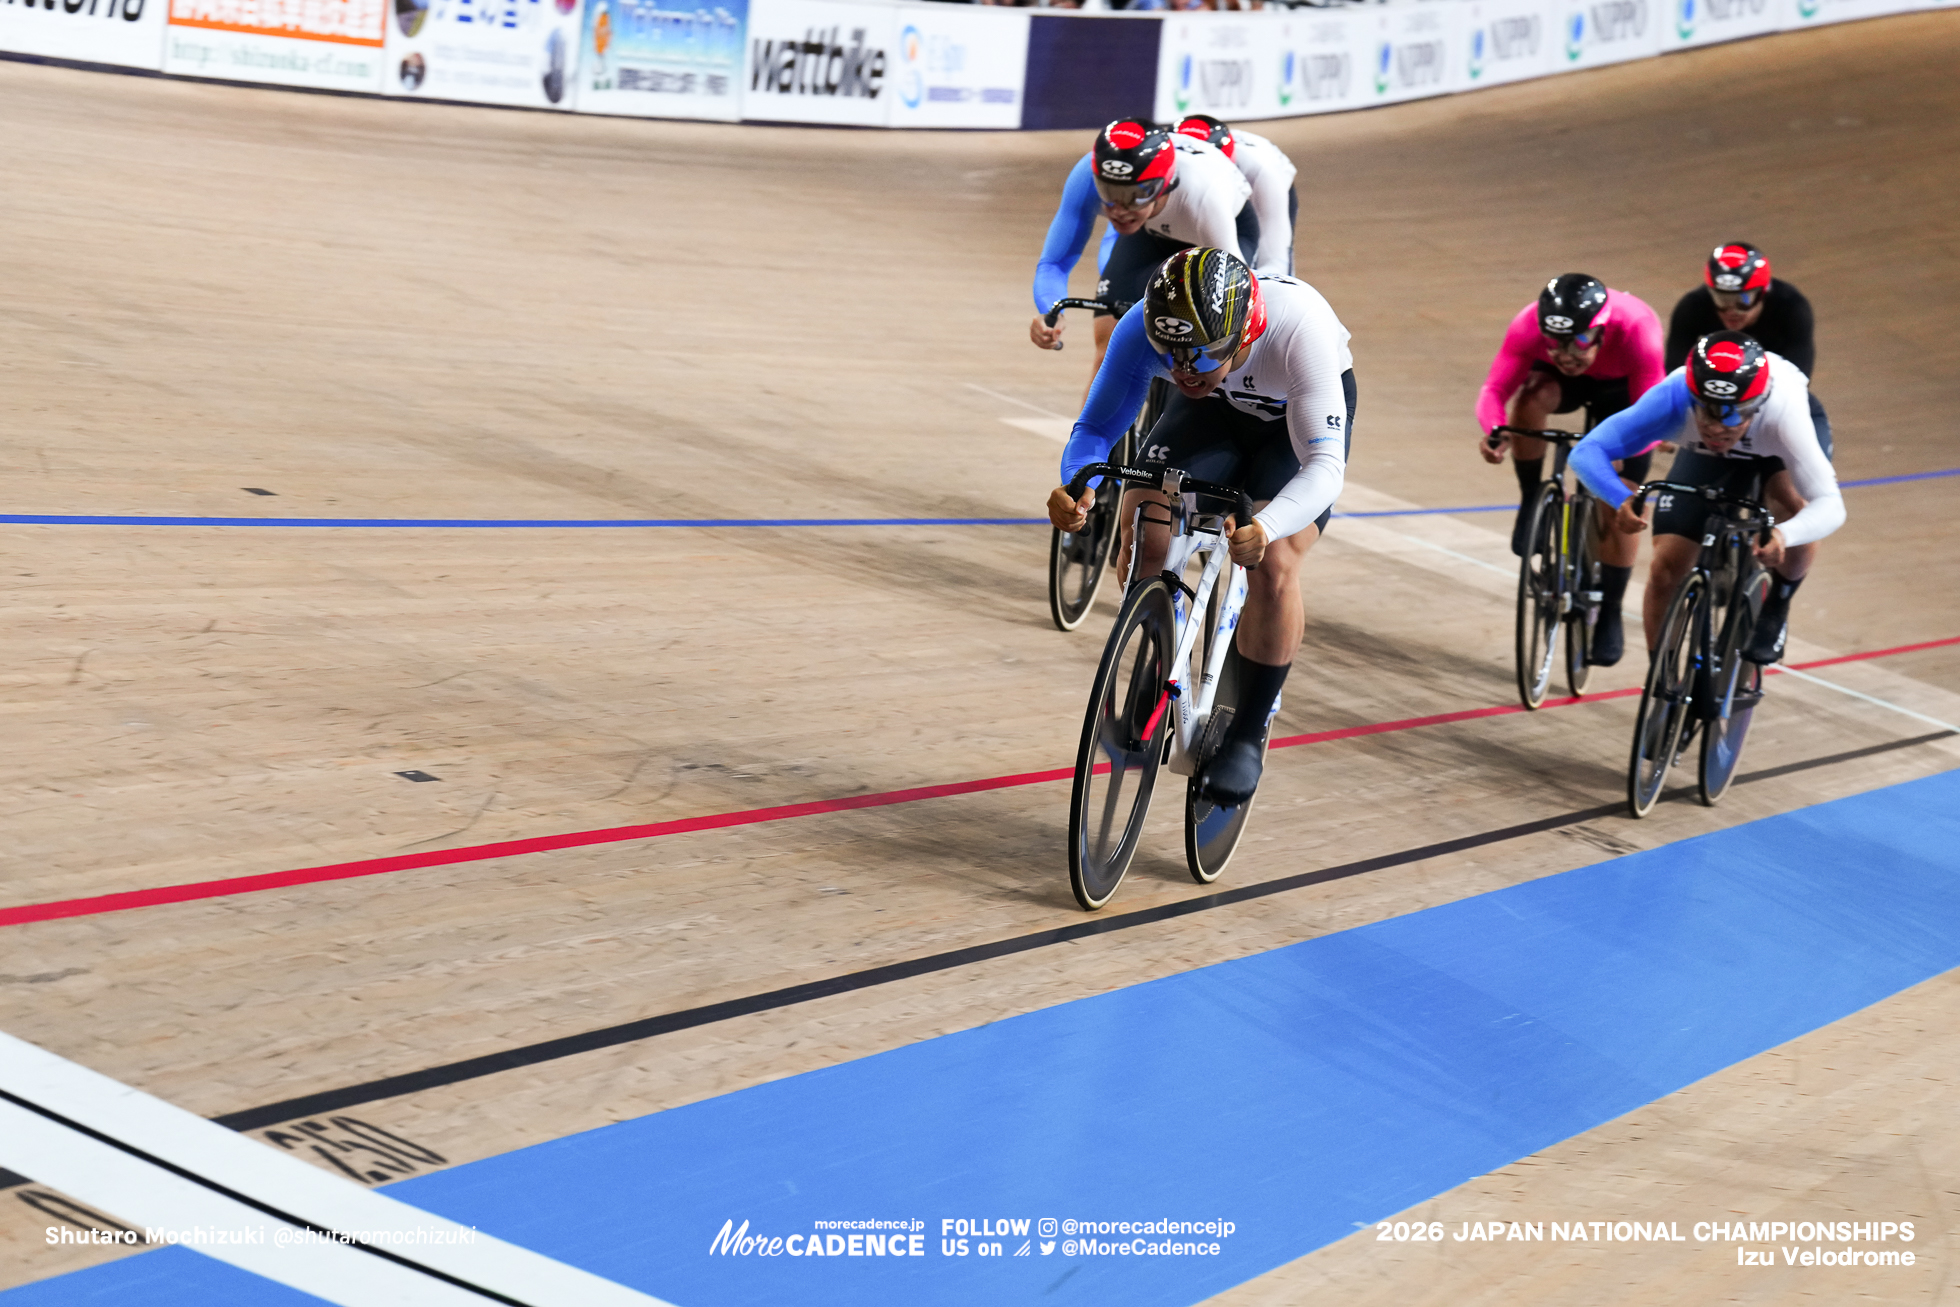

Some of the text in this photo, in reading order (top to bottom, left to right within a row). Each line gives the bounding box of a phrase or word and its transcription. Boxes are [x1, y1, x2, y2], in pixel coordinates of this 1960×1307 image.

[751, 25, 886, 99] wattbike
[1155, 330, 1193, 342] Kabuto
[1120, 466, 1153, 479] Velobike
[263, 1115, 448, 1184] 250
